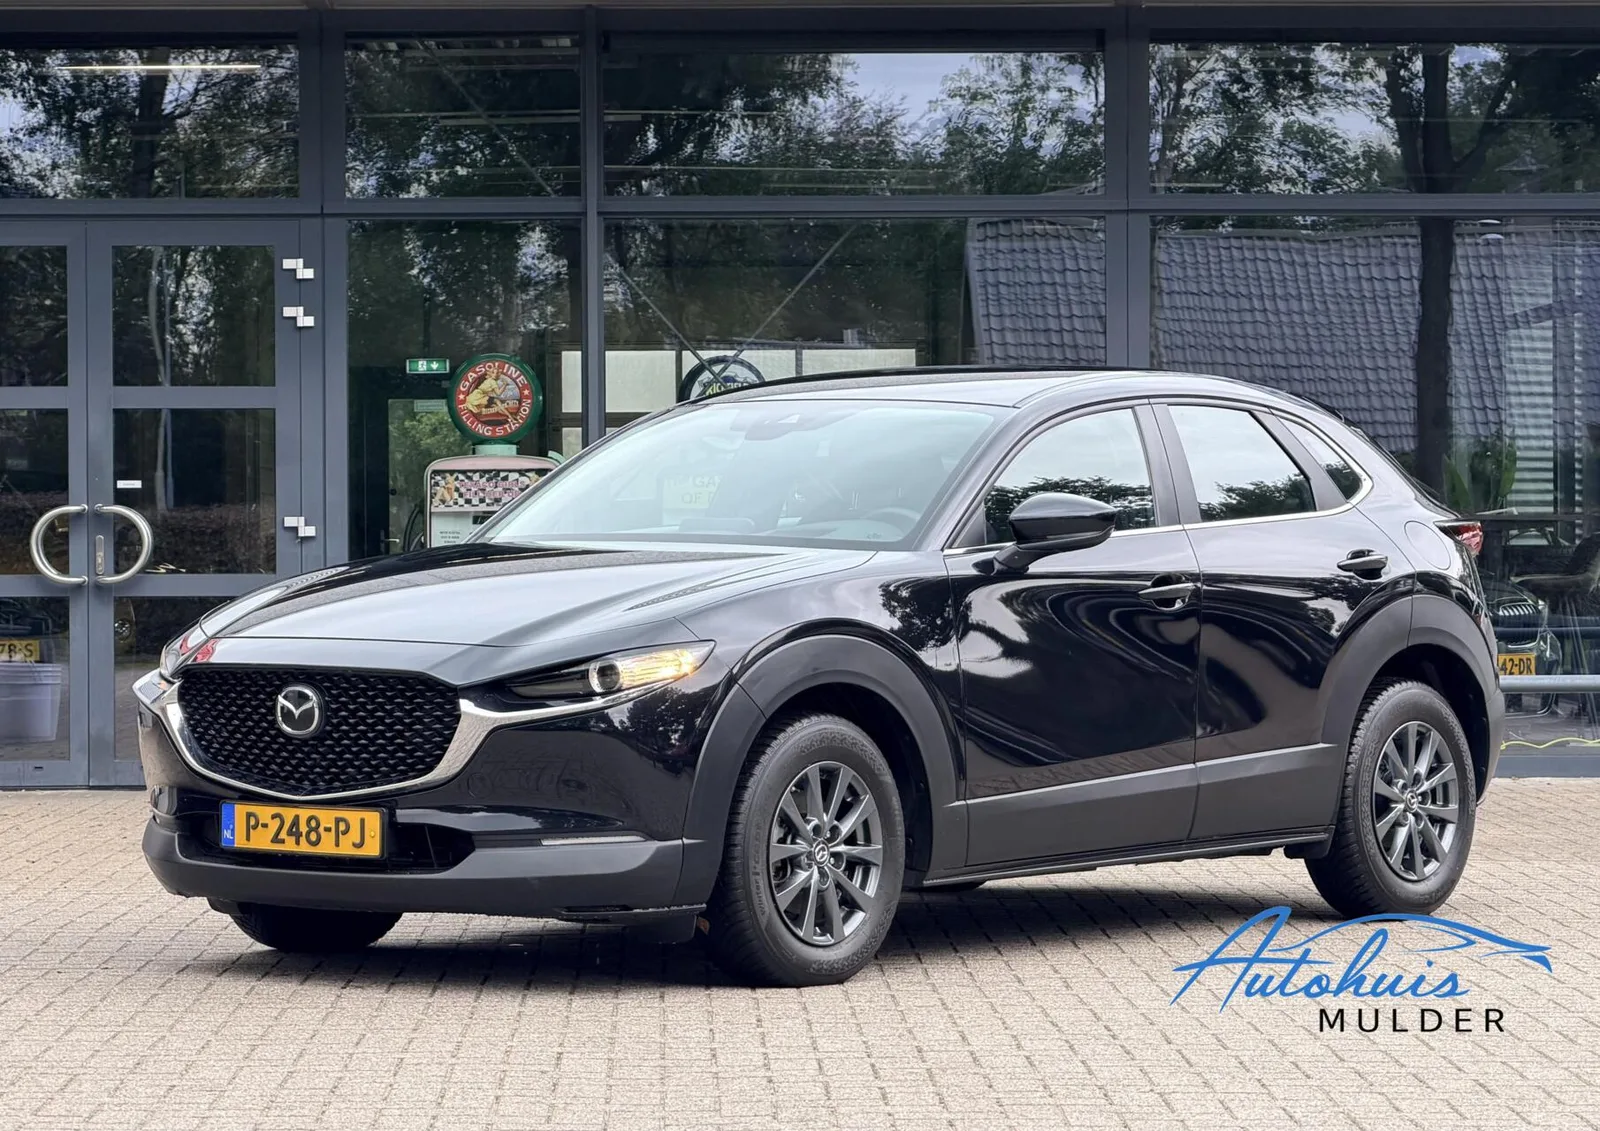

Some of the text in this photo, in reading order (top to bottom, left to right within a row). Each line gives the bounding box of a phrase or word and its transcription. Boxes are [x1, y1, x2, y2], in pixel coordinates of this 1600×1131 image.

[459, 362, 528, 391] GASOLINE
[458, 399, 532, 436] FILLING STATION
[1497, 657, 1533, 676] 42-DR
[223, 829, 235, 840] NL
[245, 811, 366, 849] P-248-PJ
